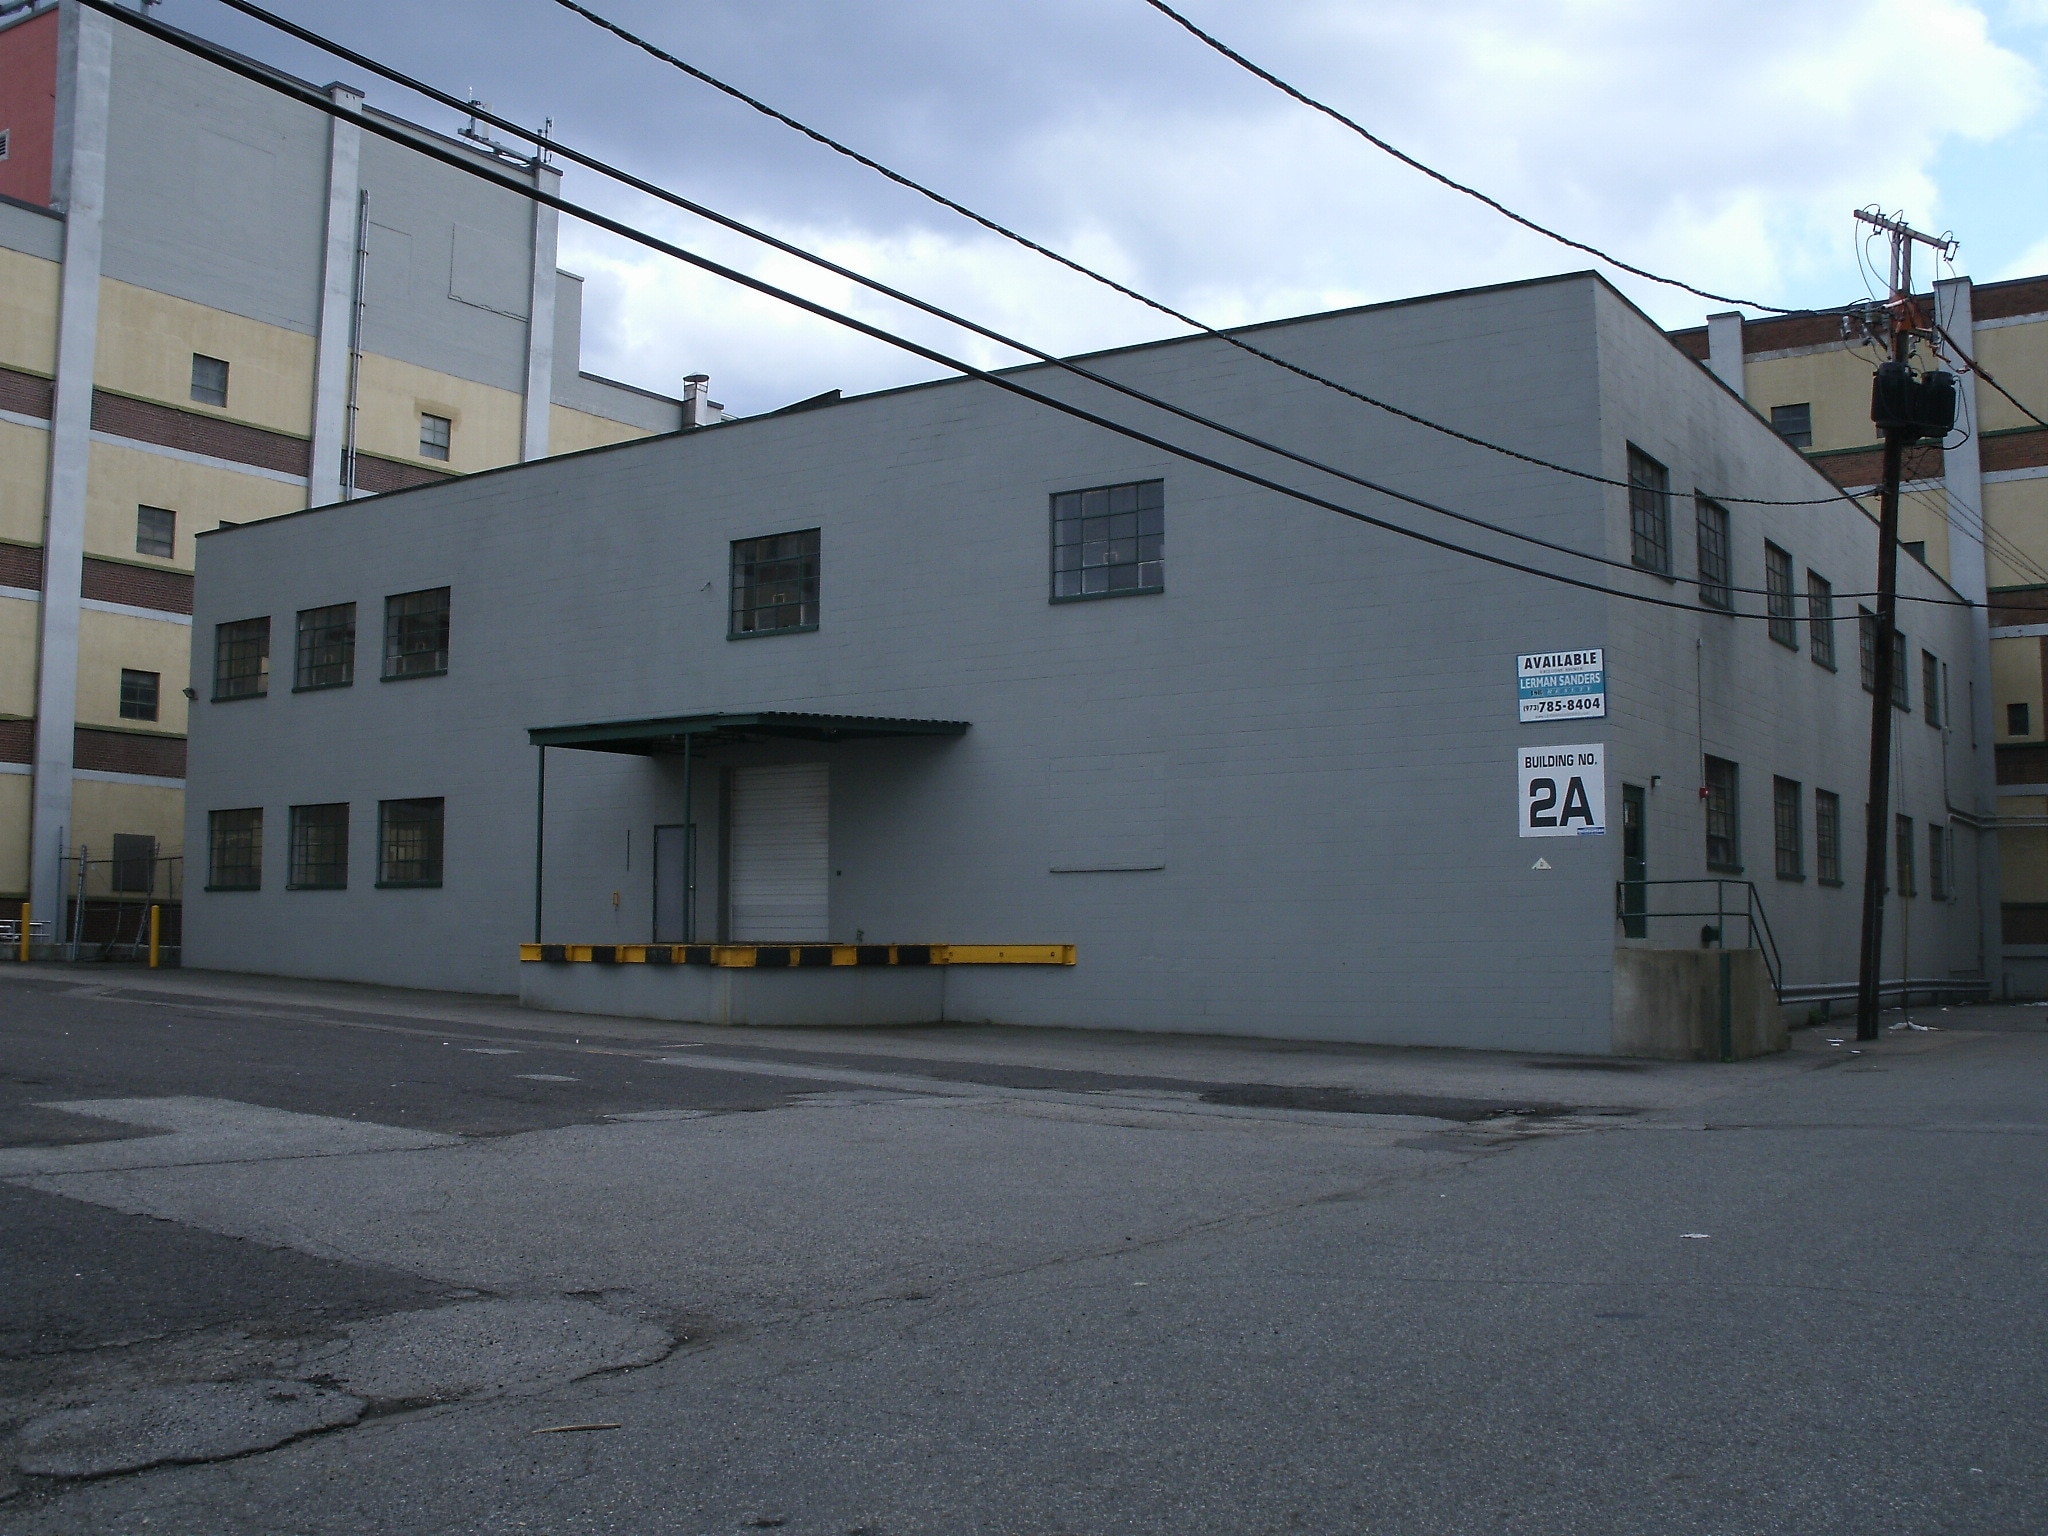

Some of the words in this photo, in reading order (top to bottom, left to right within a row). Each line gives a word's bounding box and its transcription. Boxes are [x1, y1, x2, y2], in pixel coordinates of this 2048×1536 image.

[1524, 652, 1597, 670] AVAILABLE
[1520, 676, 1557, 689] LERMAN
[1558, 672, 1601, 686] SANDERS
[1525, 754, 1574, 768] BUILDING
[1578, 753, 1598, 766] NO.
[1529, 776, 1595, 828] 2A
